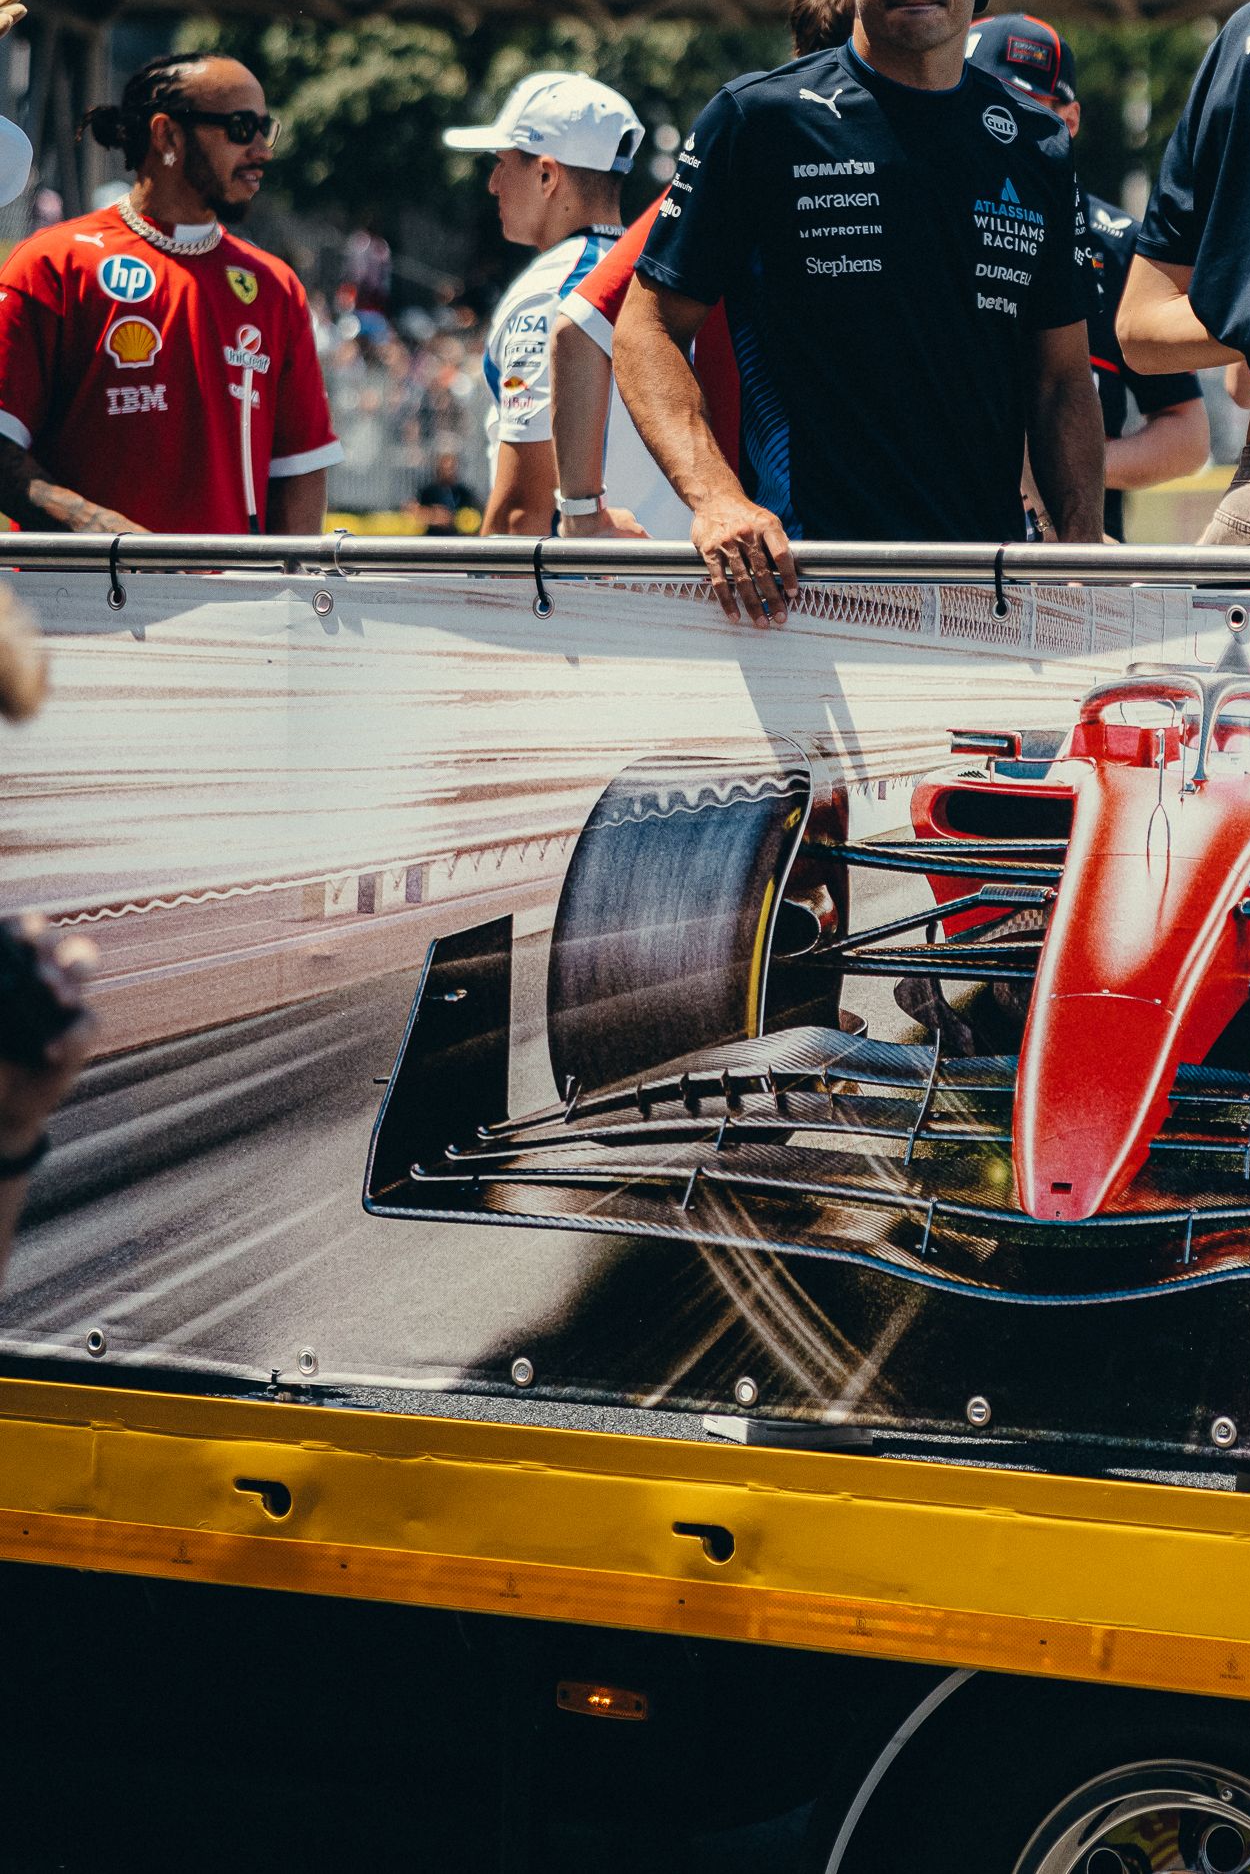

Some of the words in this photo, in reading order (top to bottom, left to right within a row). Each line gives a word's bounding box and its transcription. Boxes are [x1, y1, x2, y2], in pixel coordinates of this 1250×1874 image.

[986, 115, 1016, 134] Gulf
[793, 159, 876, 178] KOMATSU
[814, 192, 880, 209] kraken
[974, 198, 1045, 226] ATLASSIAN
[811, 225, 883, 238] MYPROTEIN
[973, 214, 1046, 243] WILLIAMS
[983, 232, 1038, 257] RACING
[109, 255, 148, 301] hp
[806, 254, 883, 278] Stephens
[507, 315, 548, 335] VISA
[105, 384, 169, 416] IBM
